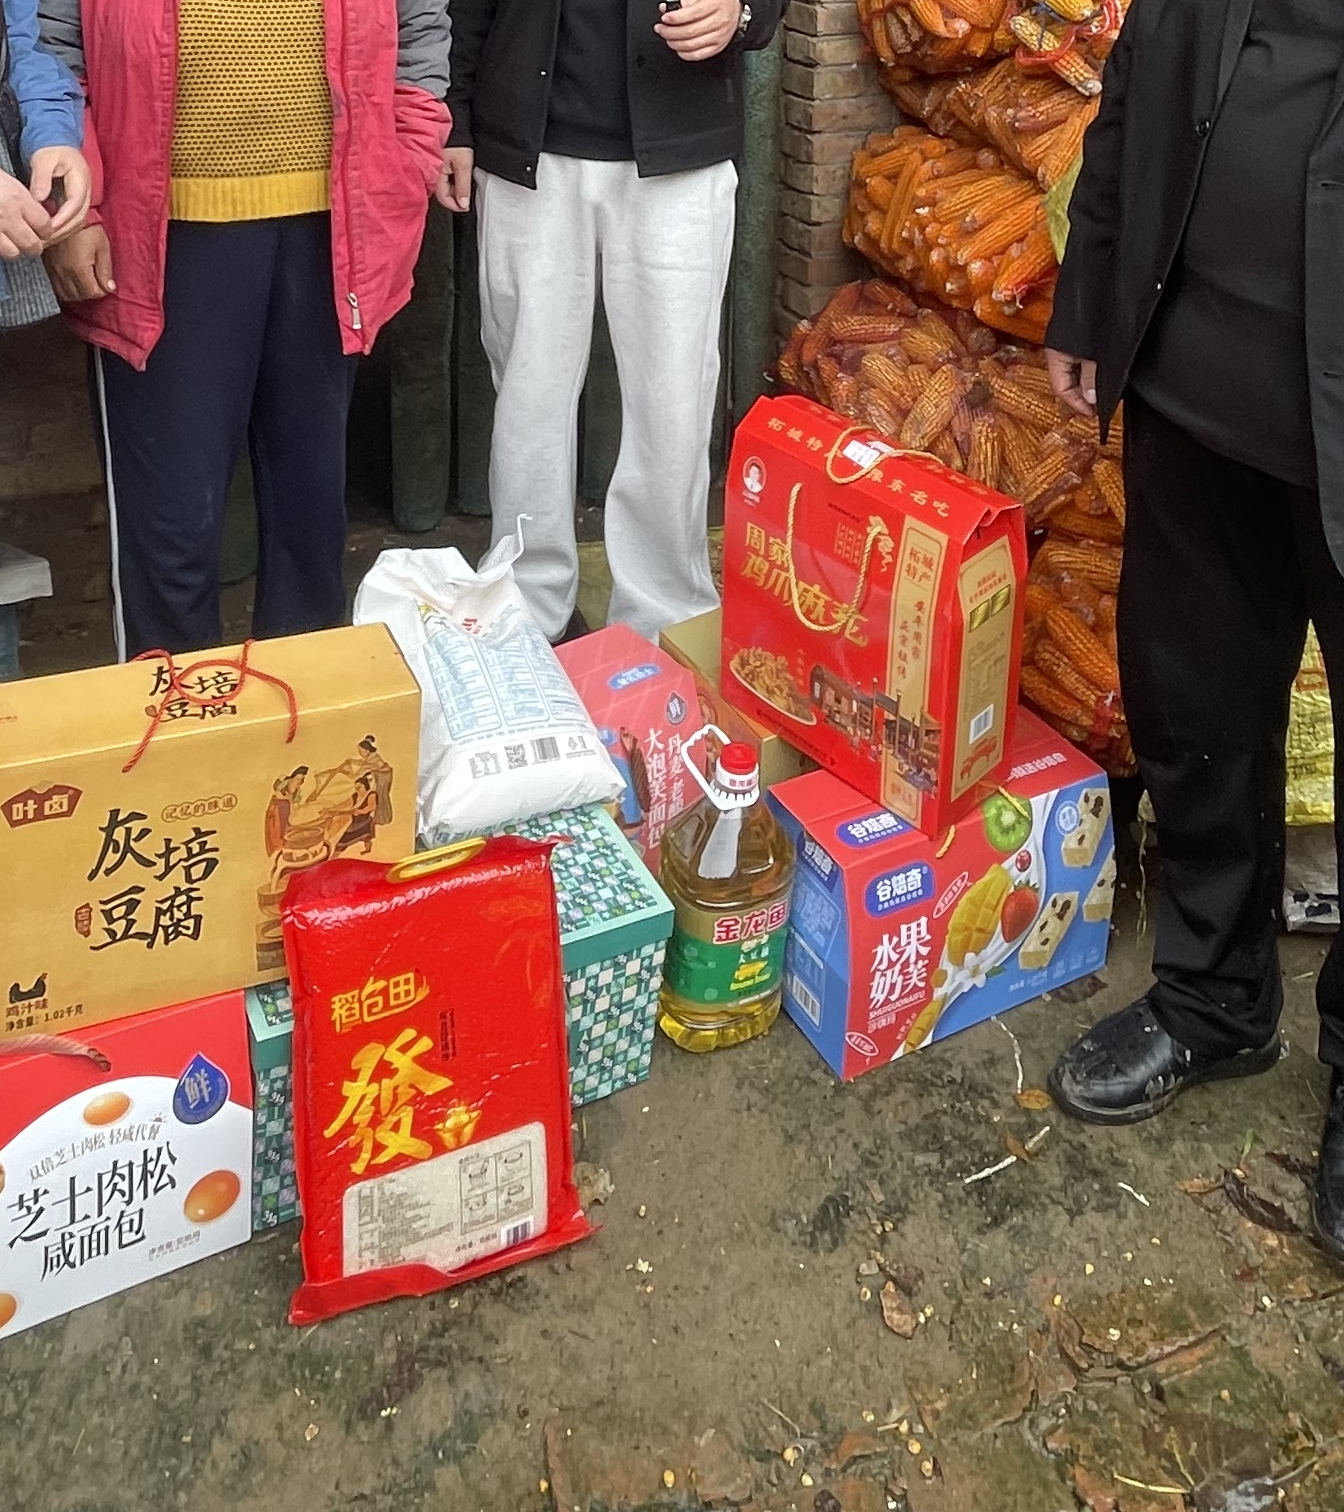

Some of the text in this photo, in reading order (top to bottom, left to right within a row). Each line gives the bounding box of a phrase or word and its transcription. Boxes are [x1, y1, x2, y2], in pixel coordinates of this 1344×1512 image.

[11, 794, 69, 821] 叶卤
[164, 794, 235, 820] 记忆的味道
[87, 808, 220, 884] 灰培
[90, 885, 204, 951] 豆腐
[713, 899, 788, 944] 金龙鱼
[869, 916, 932, 973] 水果
[869, 960, 930, 1009] 奶芙
[184, 1068, 212, 1109] 鲜
[323, 1028, 454, 1175] 發
[7, 1141, 177, 1249] 芝士肉松
[41, 1207, 146, 1282] 咸面包
